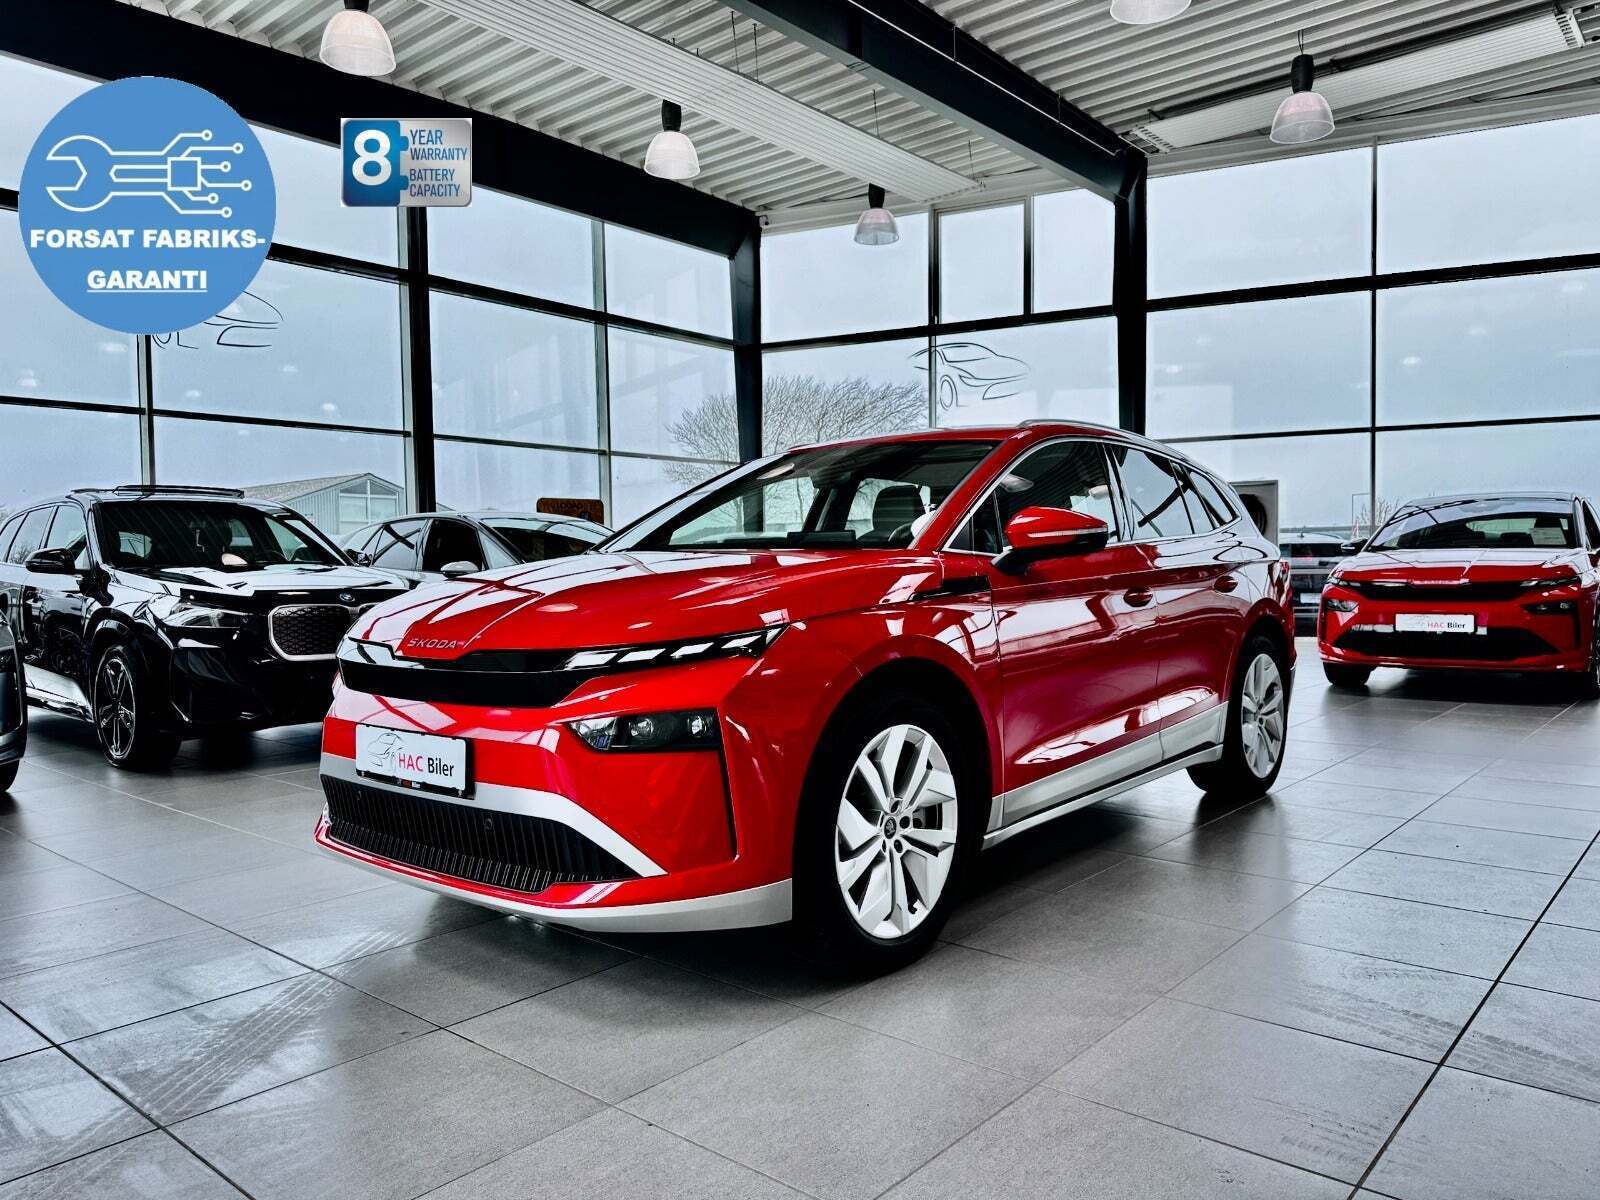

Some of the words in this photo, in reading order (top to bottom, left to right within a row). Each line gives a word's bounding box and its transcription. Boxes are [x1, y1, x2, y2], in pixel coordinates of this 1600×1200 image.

[1447, 621, 1466, 629] Biler
[399, 754, 424, 772] HAC
[427, 756, 455, 777] Biler
